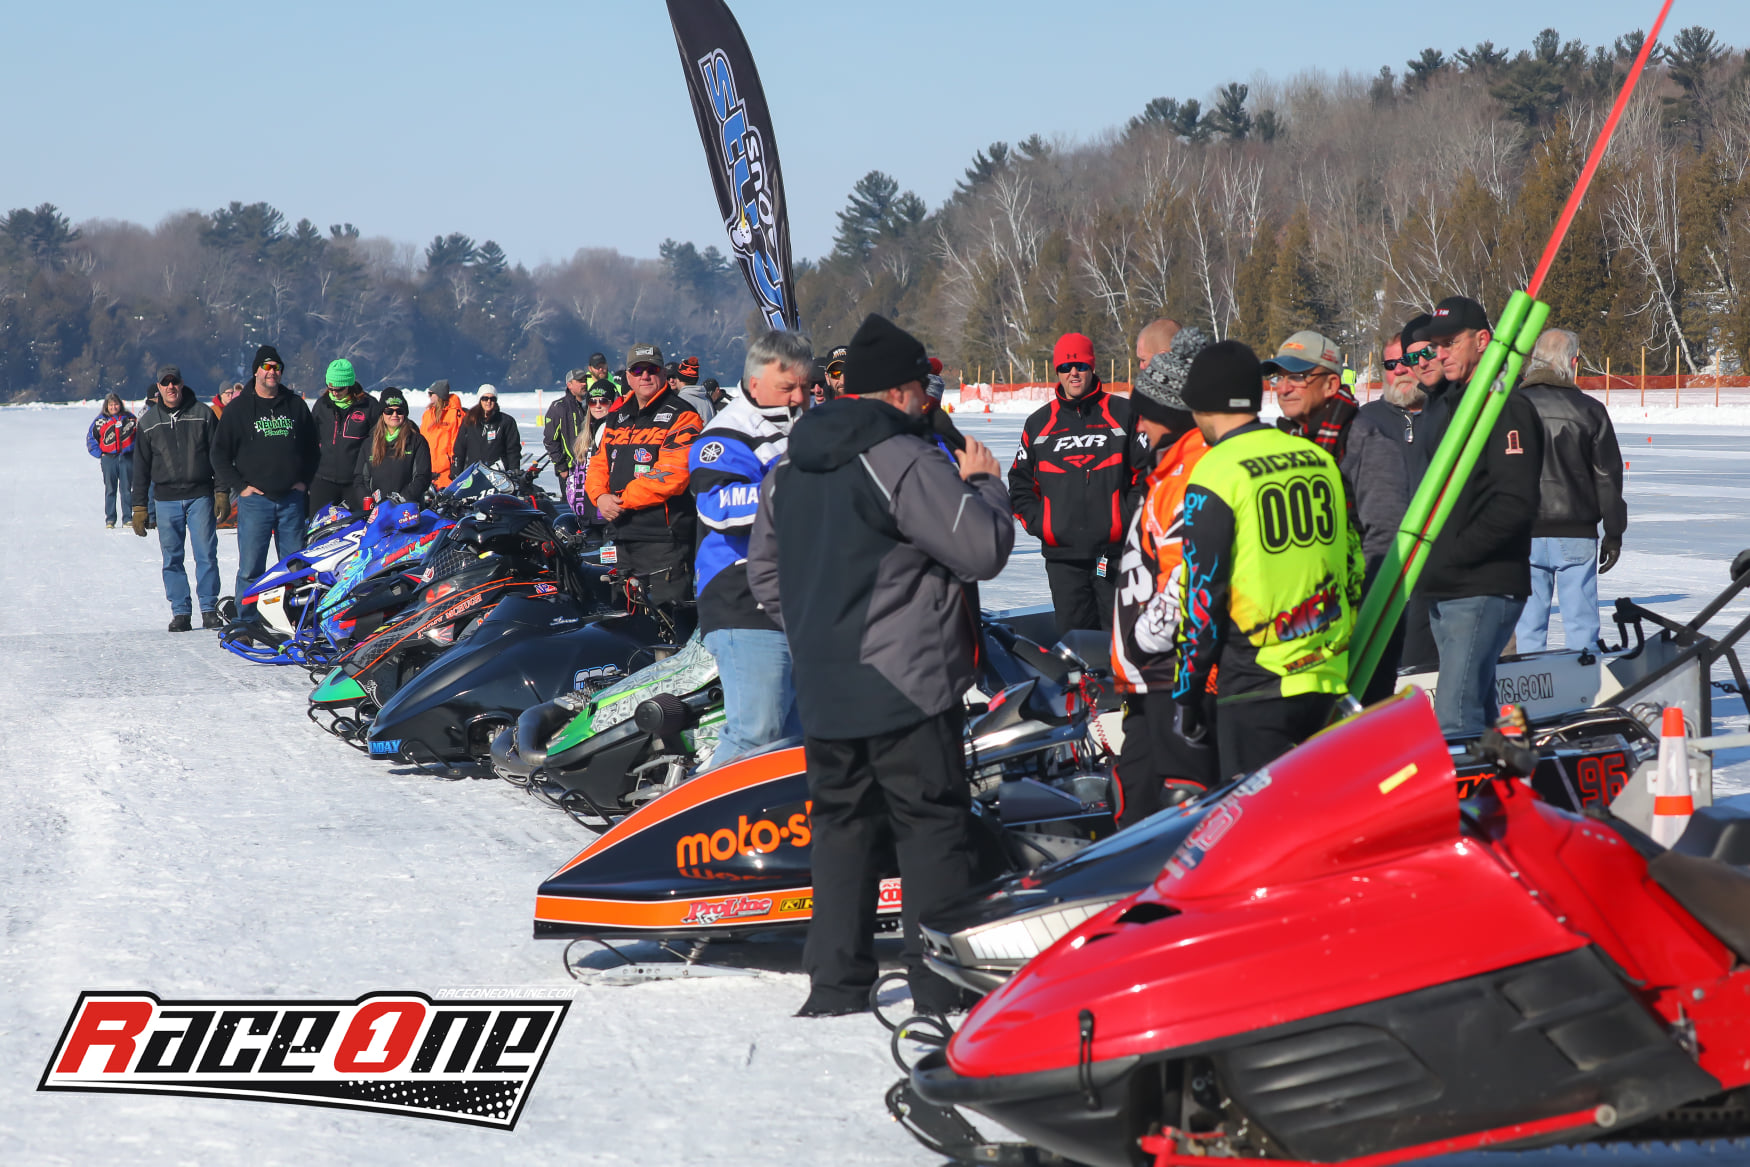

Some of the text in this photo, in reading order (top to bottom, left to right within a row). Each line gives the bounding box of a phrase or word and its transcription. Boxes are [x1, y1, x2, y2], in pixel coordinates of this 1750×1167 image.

[1053, 434, 1107, 452] FXR
[1238, 450, 1328, 479] BICKEL
[719, 486, 761, 508] YAMA
[1257, 474, 1336, 553] 003
[445, 593, 482, 619] MCHUGH
[1577, 752, 1628, 809] 96
